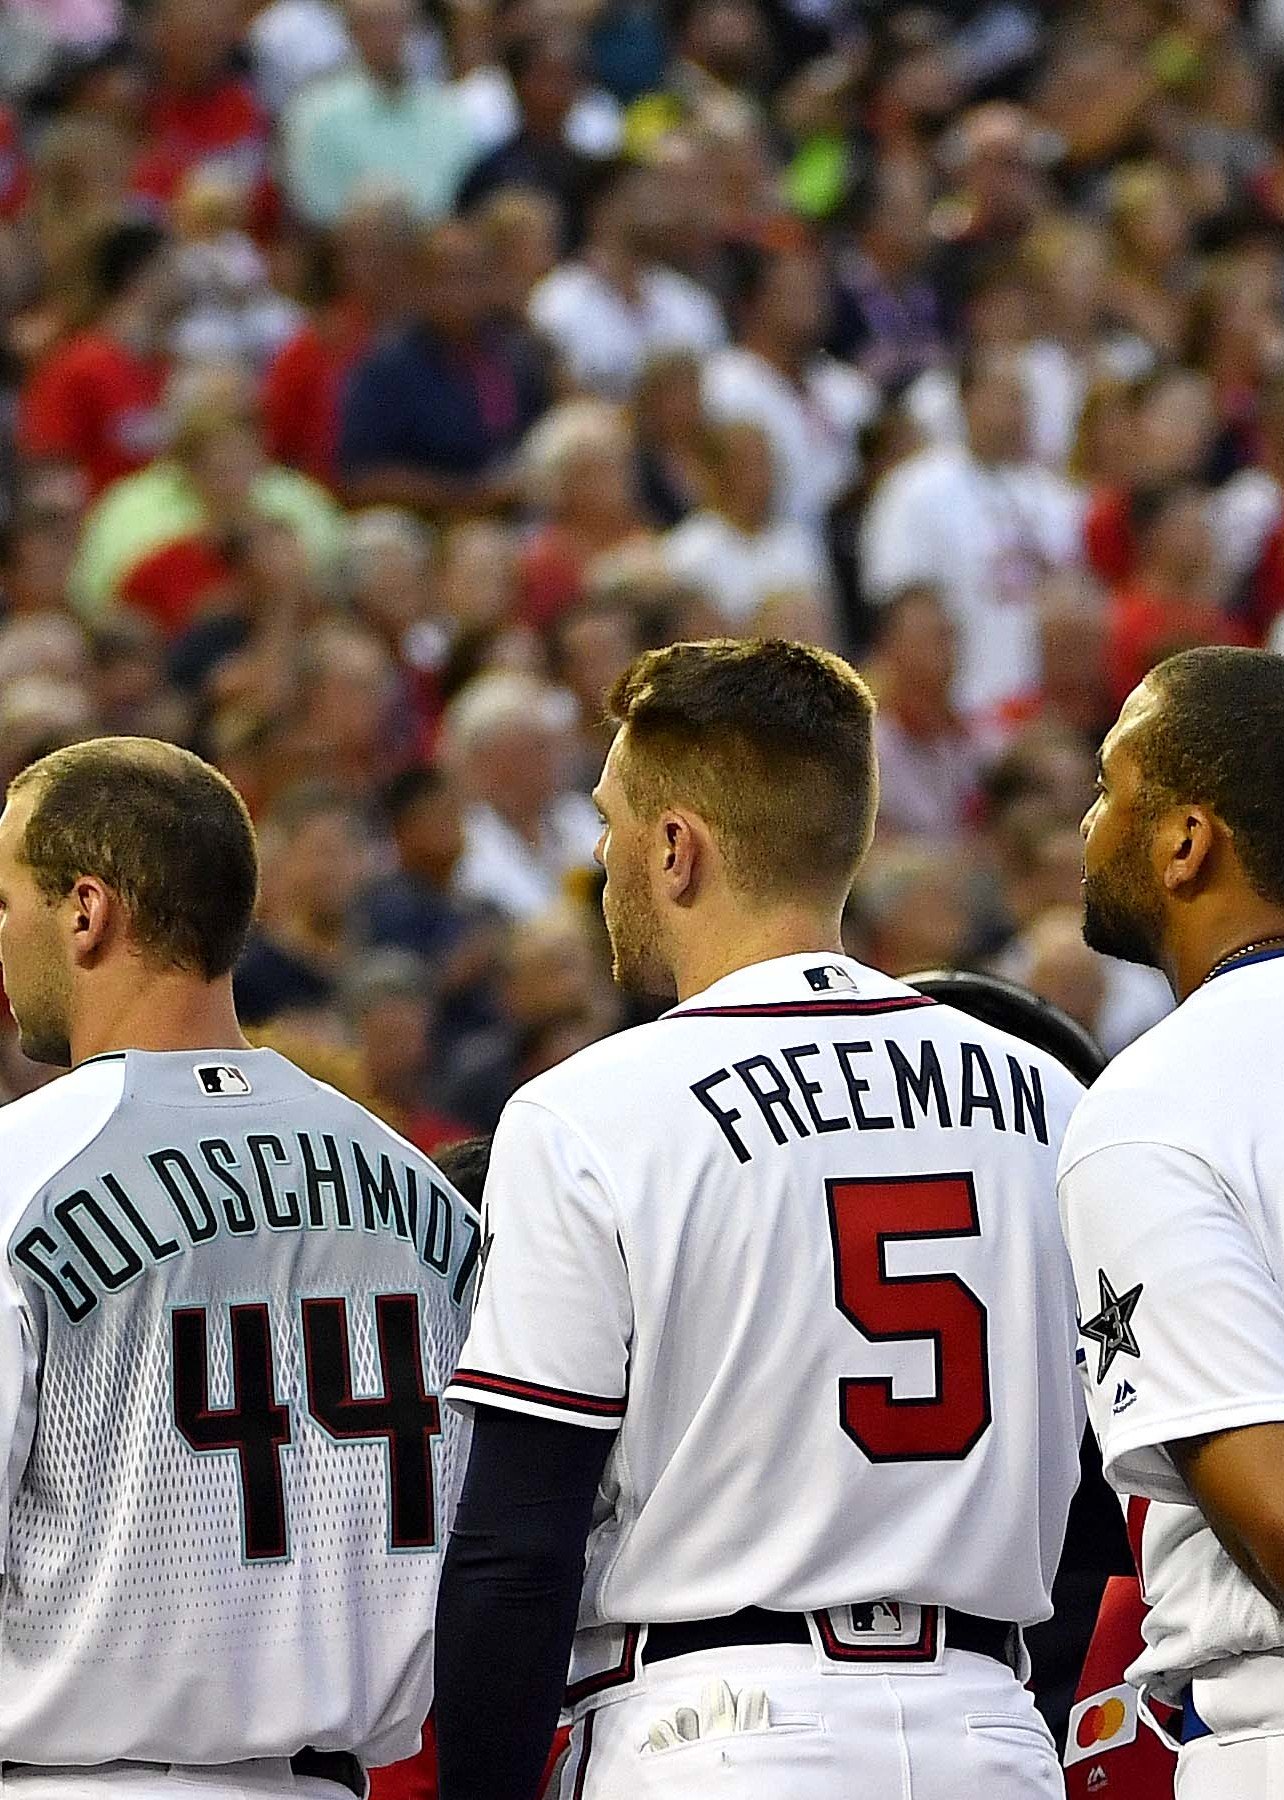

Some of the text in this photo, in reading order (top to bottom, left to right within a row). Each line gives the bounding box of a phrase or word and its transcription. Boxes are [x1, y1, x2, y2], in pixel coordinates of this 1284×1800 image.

[689, 1038, 1050, 1165] FREEMAN
[11, 1130, 481, 1325] GOLDSCHMIDT
[823, 1170, 993, 1465] 5
[169, 1292, 443, 1565] 44
